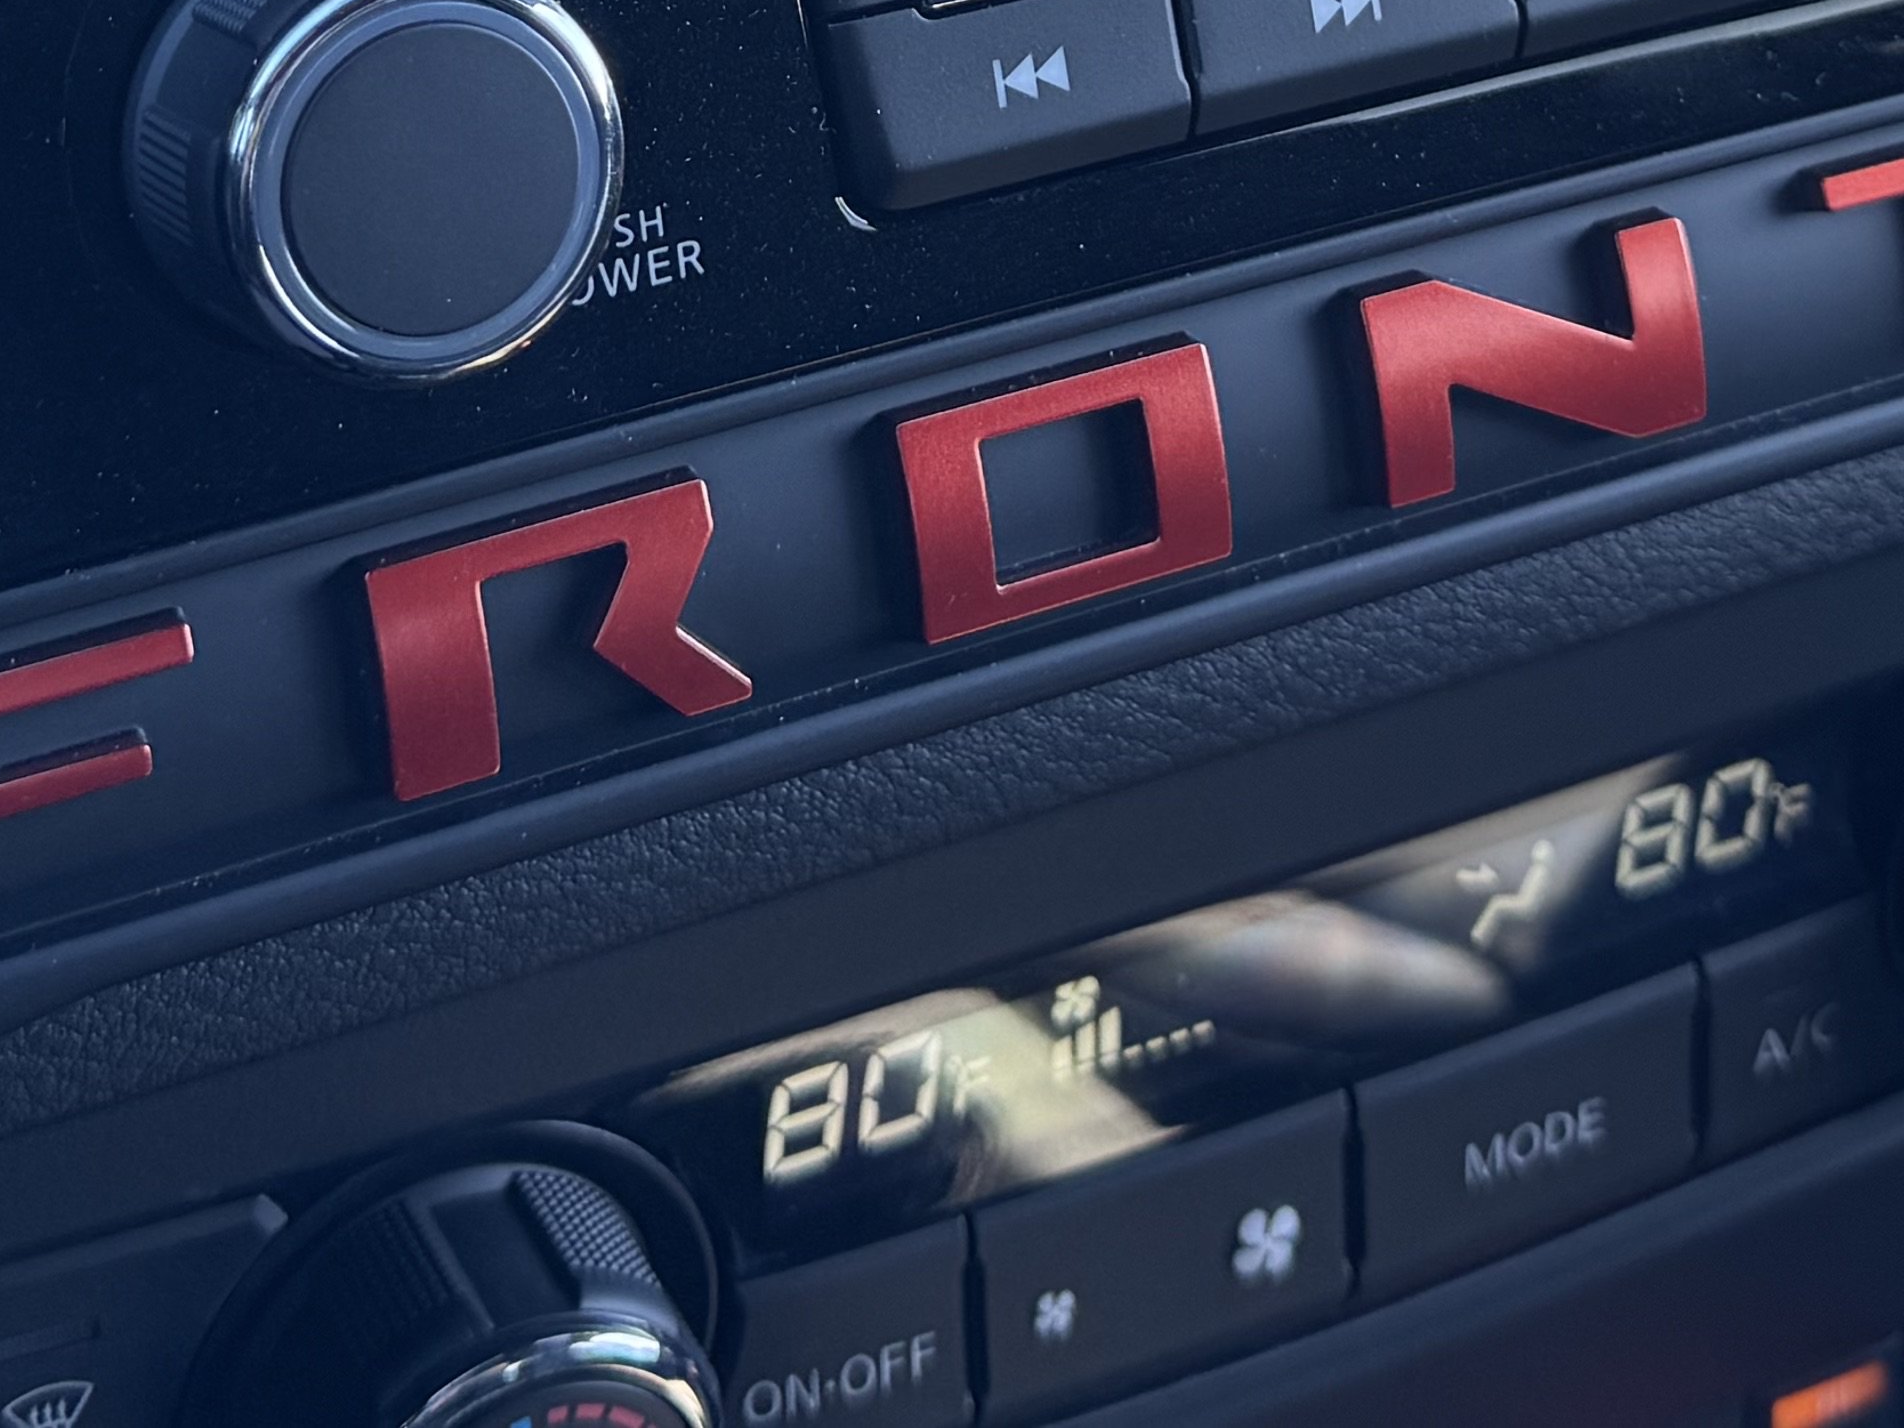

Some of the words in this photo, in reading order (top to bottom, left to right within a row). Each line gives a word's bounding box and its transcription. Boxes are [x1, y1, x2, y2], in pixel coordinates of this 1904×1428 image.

[613, 205, 665, 248] SH
[1752, 1001, 1842, 1079] A/C
[1464, 1096, 1607, 1190] MODE
